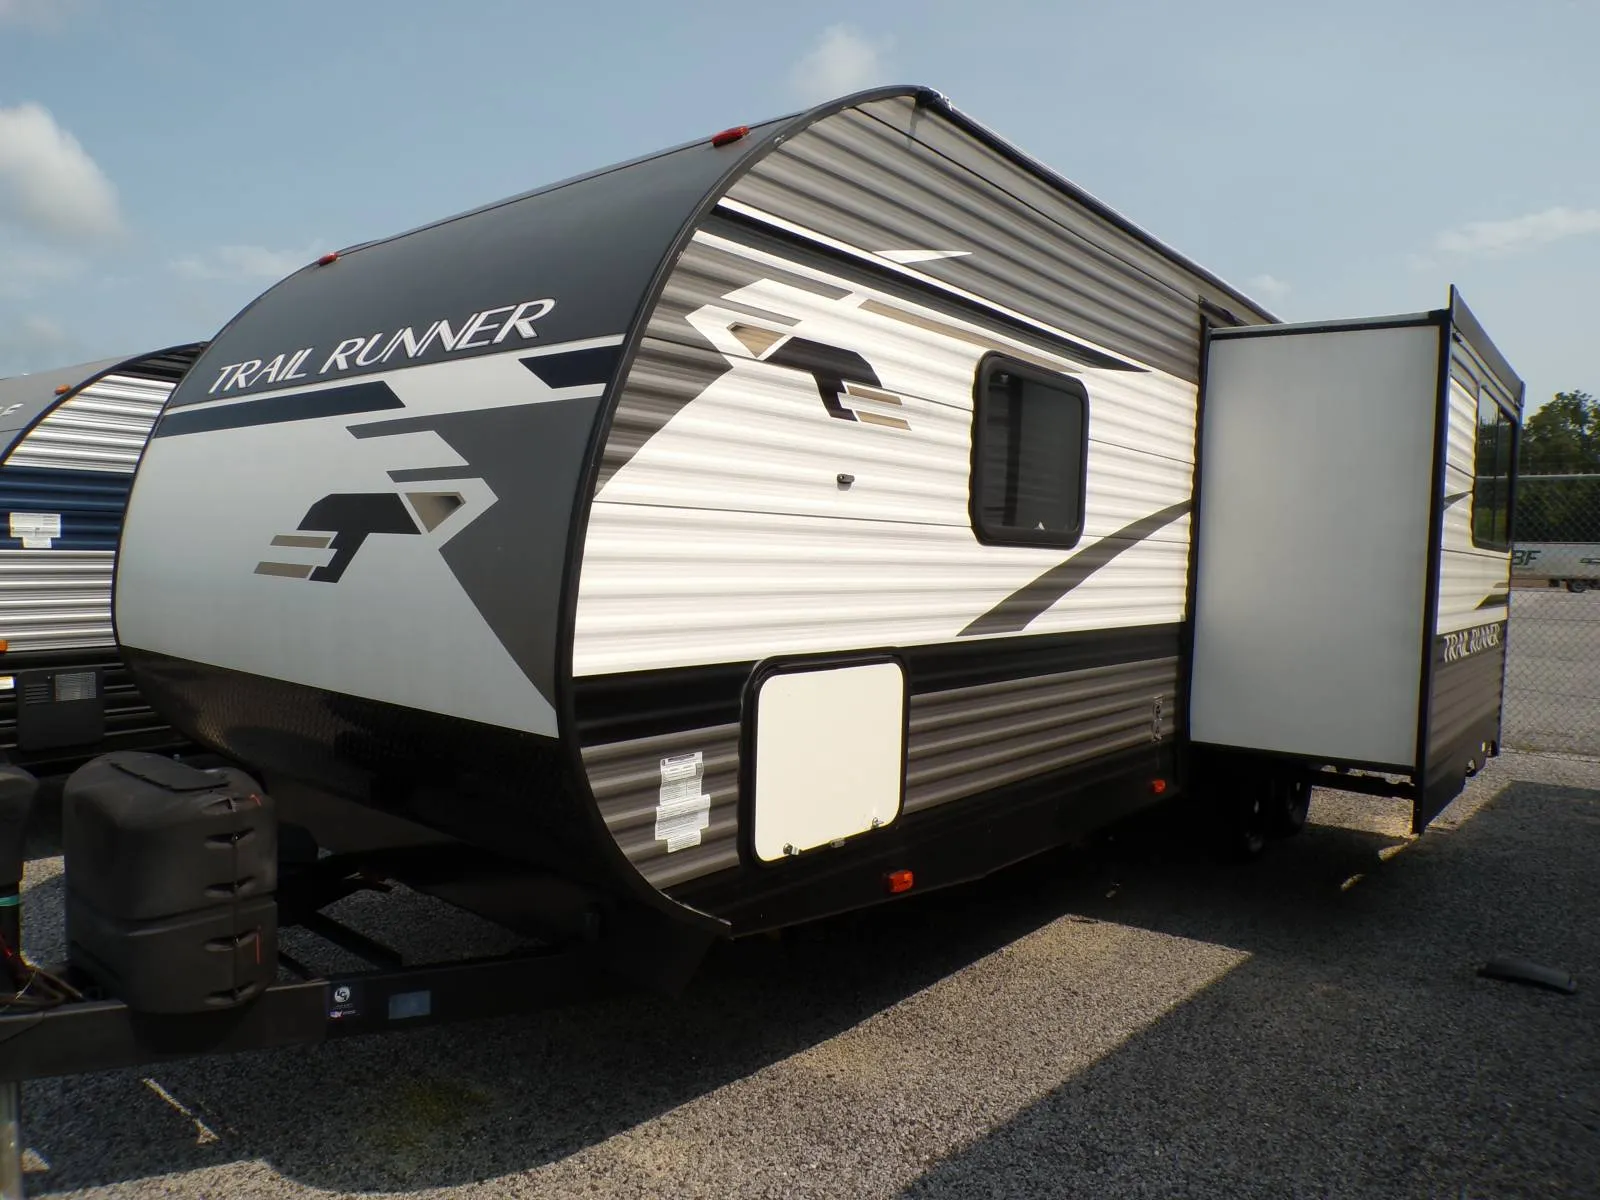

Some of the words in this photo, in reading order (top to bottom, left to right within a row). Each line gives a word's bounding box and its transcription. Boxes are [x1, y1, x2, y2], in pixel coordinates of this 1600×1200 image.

[207, 347, 314, 395] TRAIL
[319, 298, 557, 375] RUNNER
[1444, 629, 1470, 664] TRAIL
[1470, 623, 1500, 653] RUNNER
